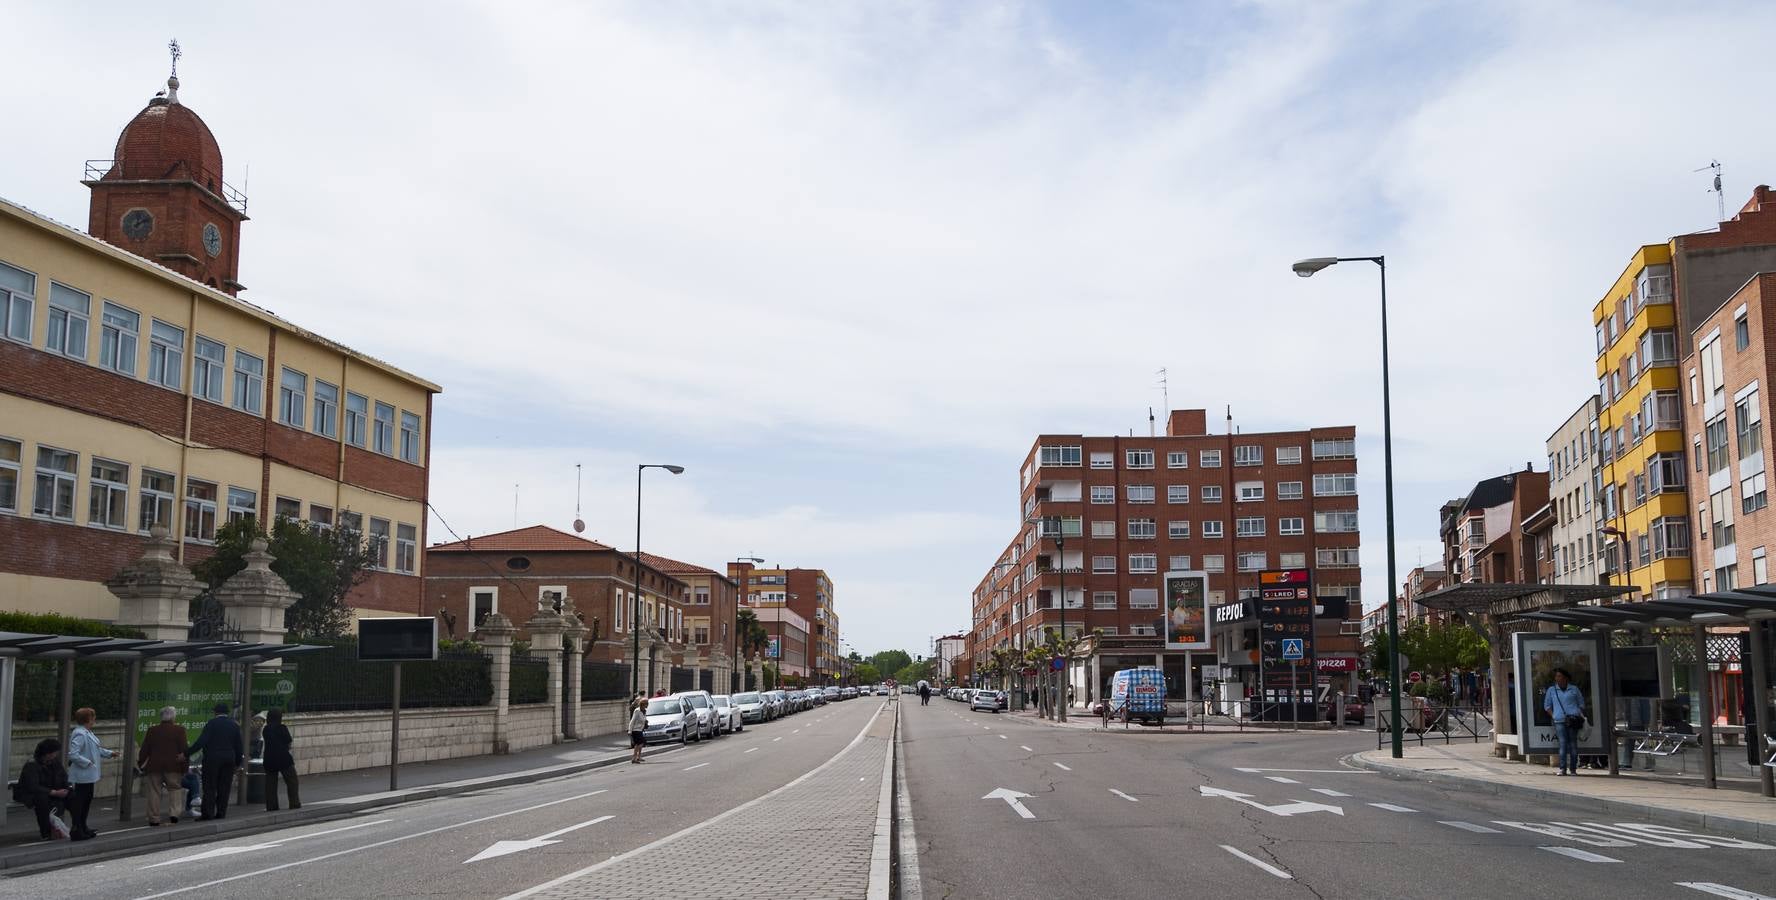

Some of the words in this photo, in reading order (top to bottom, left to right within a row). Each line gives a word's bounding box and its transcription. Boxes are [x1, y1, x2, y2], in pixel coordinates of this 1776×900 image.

[1216, 602, 1244, 623] REPSOL
[191, 693, 210, 704] mejor
[261, 695, 284, 706] BUS
[138, 708, 156, 719] para
[1489, 820, 1776, 850] BUS
